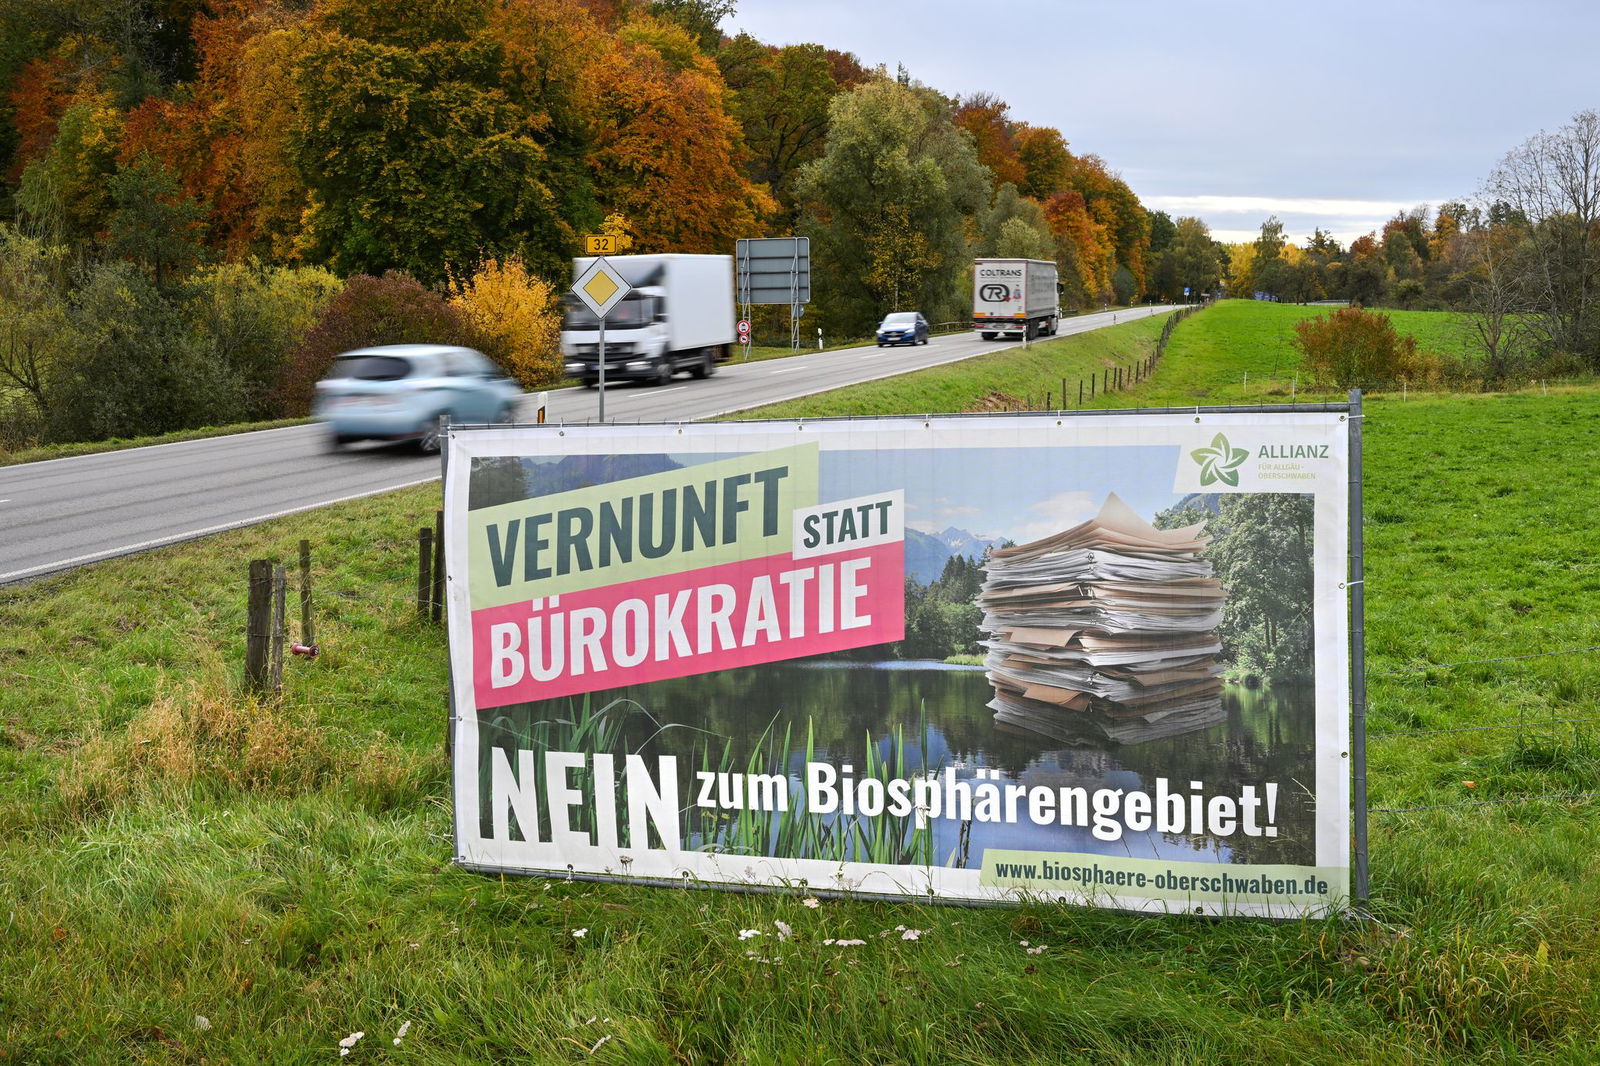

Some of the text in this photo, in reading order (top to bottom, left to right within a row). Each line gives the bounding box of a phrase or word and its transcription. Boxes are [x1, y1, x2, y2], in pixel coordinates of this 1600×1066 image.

[593, 239, 609, 251] 32
[979, 269, 1022, 277] COLTRANS
[1258, 444, 1329, 459] ALLIANZ
[1257, 472, 1316, 480] OBERSCHWABEN
[1258, 462, 1272, 470] FÜR
[486, 466, 788, 588] VERNUNFT
[803, 500, 893, 549] STATT
[490, 557, 872, 690] BÜROKRATIE
[491, 746, 1279, 850] NEIN zum Biosphärengebiet!
[995, 860, 1329, 895] www.biosphaere-oberschwaben.de
